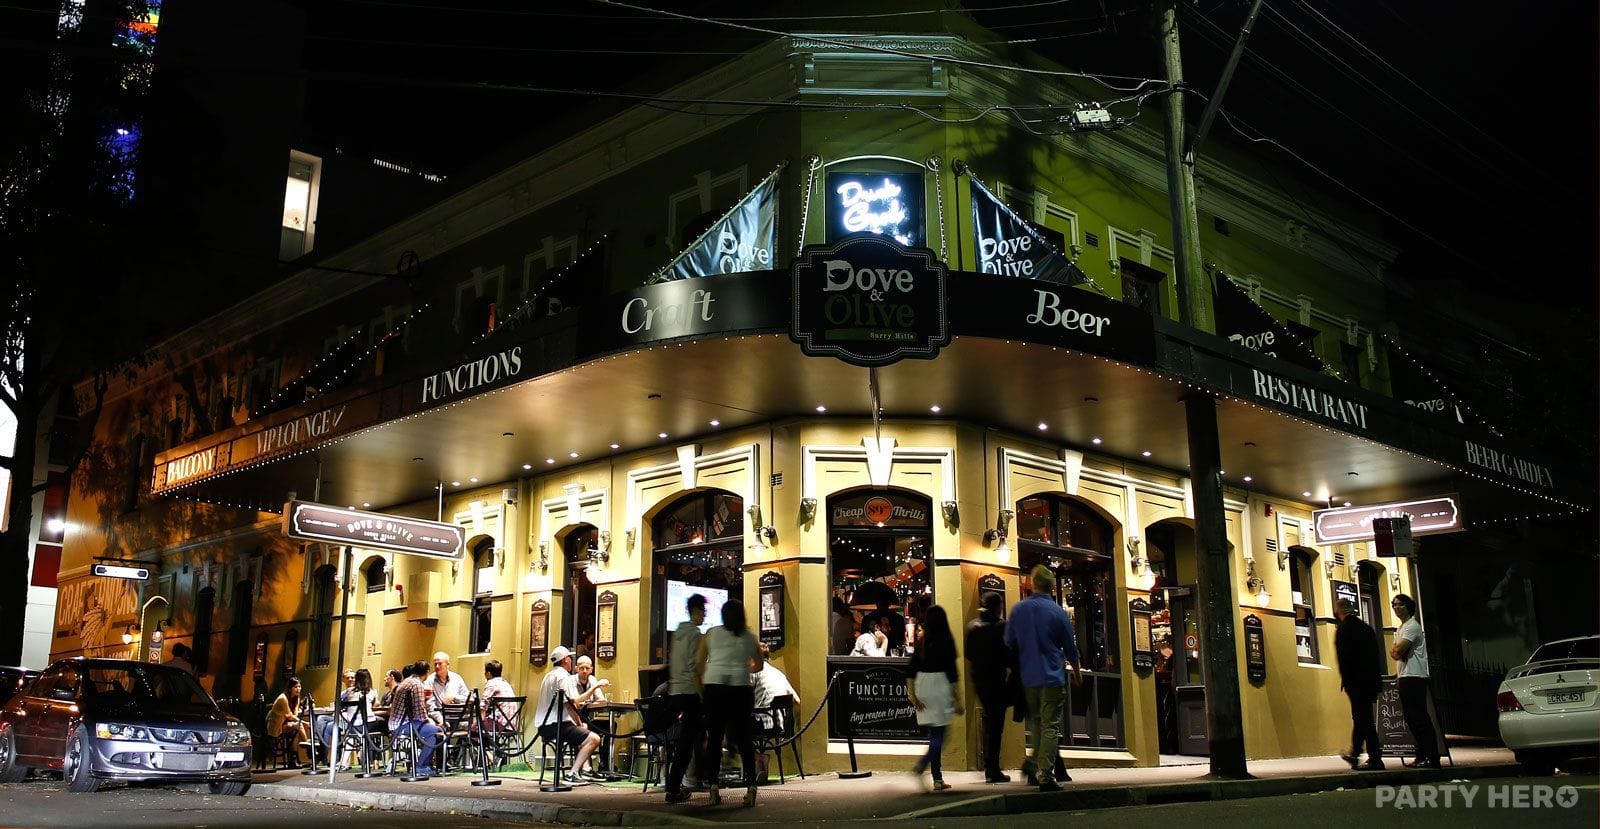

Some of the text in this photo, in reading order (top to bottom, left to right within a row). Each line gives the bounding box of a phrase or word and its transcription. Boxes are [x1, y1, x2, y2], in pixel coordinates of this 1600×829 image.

[980, 237, 1032, 261] Dove
[1005, 252, 1015, 263] &
[823, 260, 914, 292] Dove
[622, 289, 716, 334] Craft
[824, 293, 915, 327] Olive
[871, 289, 885, 301] &
[1026, 289, 1110, 336] Beer
[422, 346, 522, 403] FUNCTIONS
[1252, 368, 1368, 430] RESTAURANT
[256, 410, 330, 454] VIP LOUNGE
[166, 447, 217, 481] BALCONY
[1466, 440, 1554, 489] BEER GARDEN
[832, 506, 863, 519] Cheap
[893, 506, 925, 520] Thrills
[347, 519, 373, 533] DOVE
[386, 522, 414, 542] OLIVE
[850, 711, 864, 725] Any
[865, 710, 887, 719] reason
[887, 708, 895, 716] to
